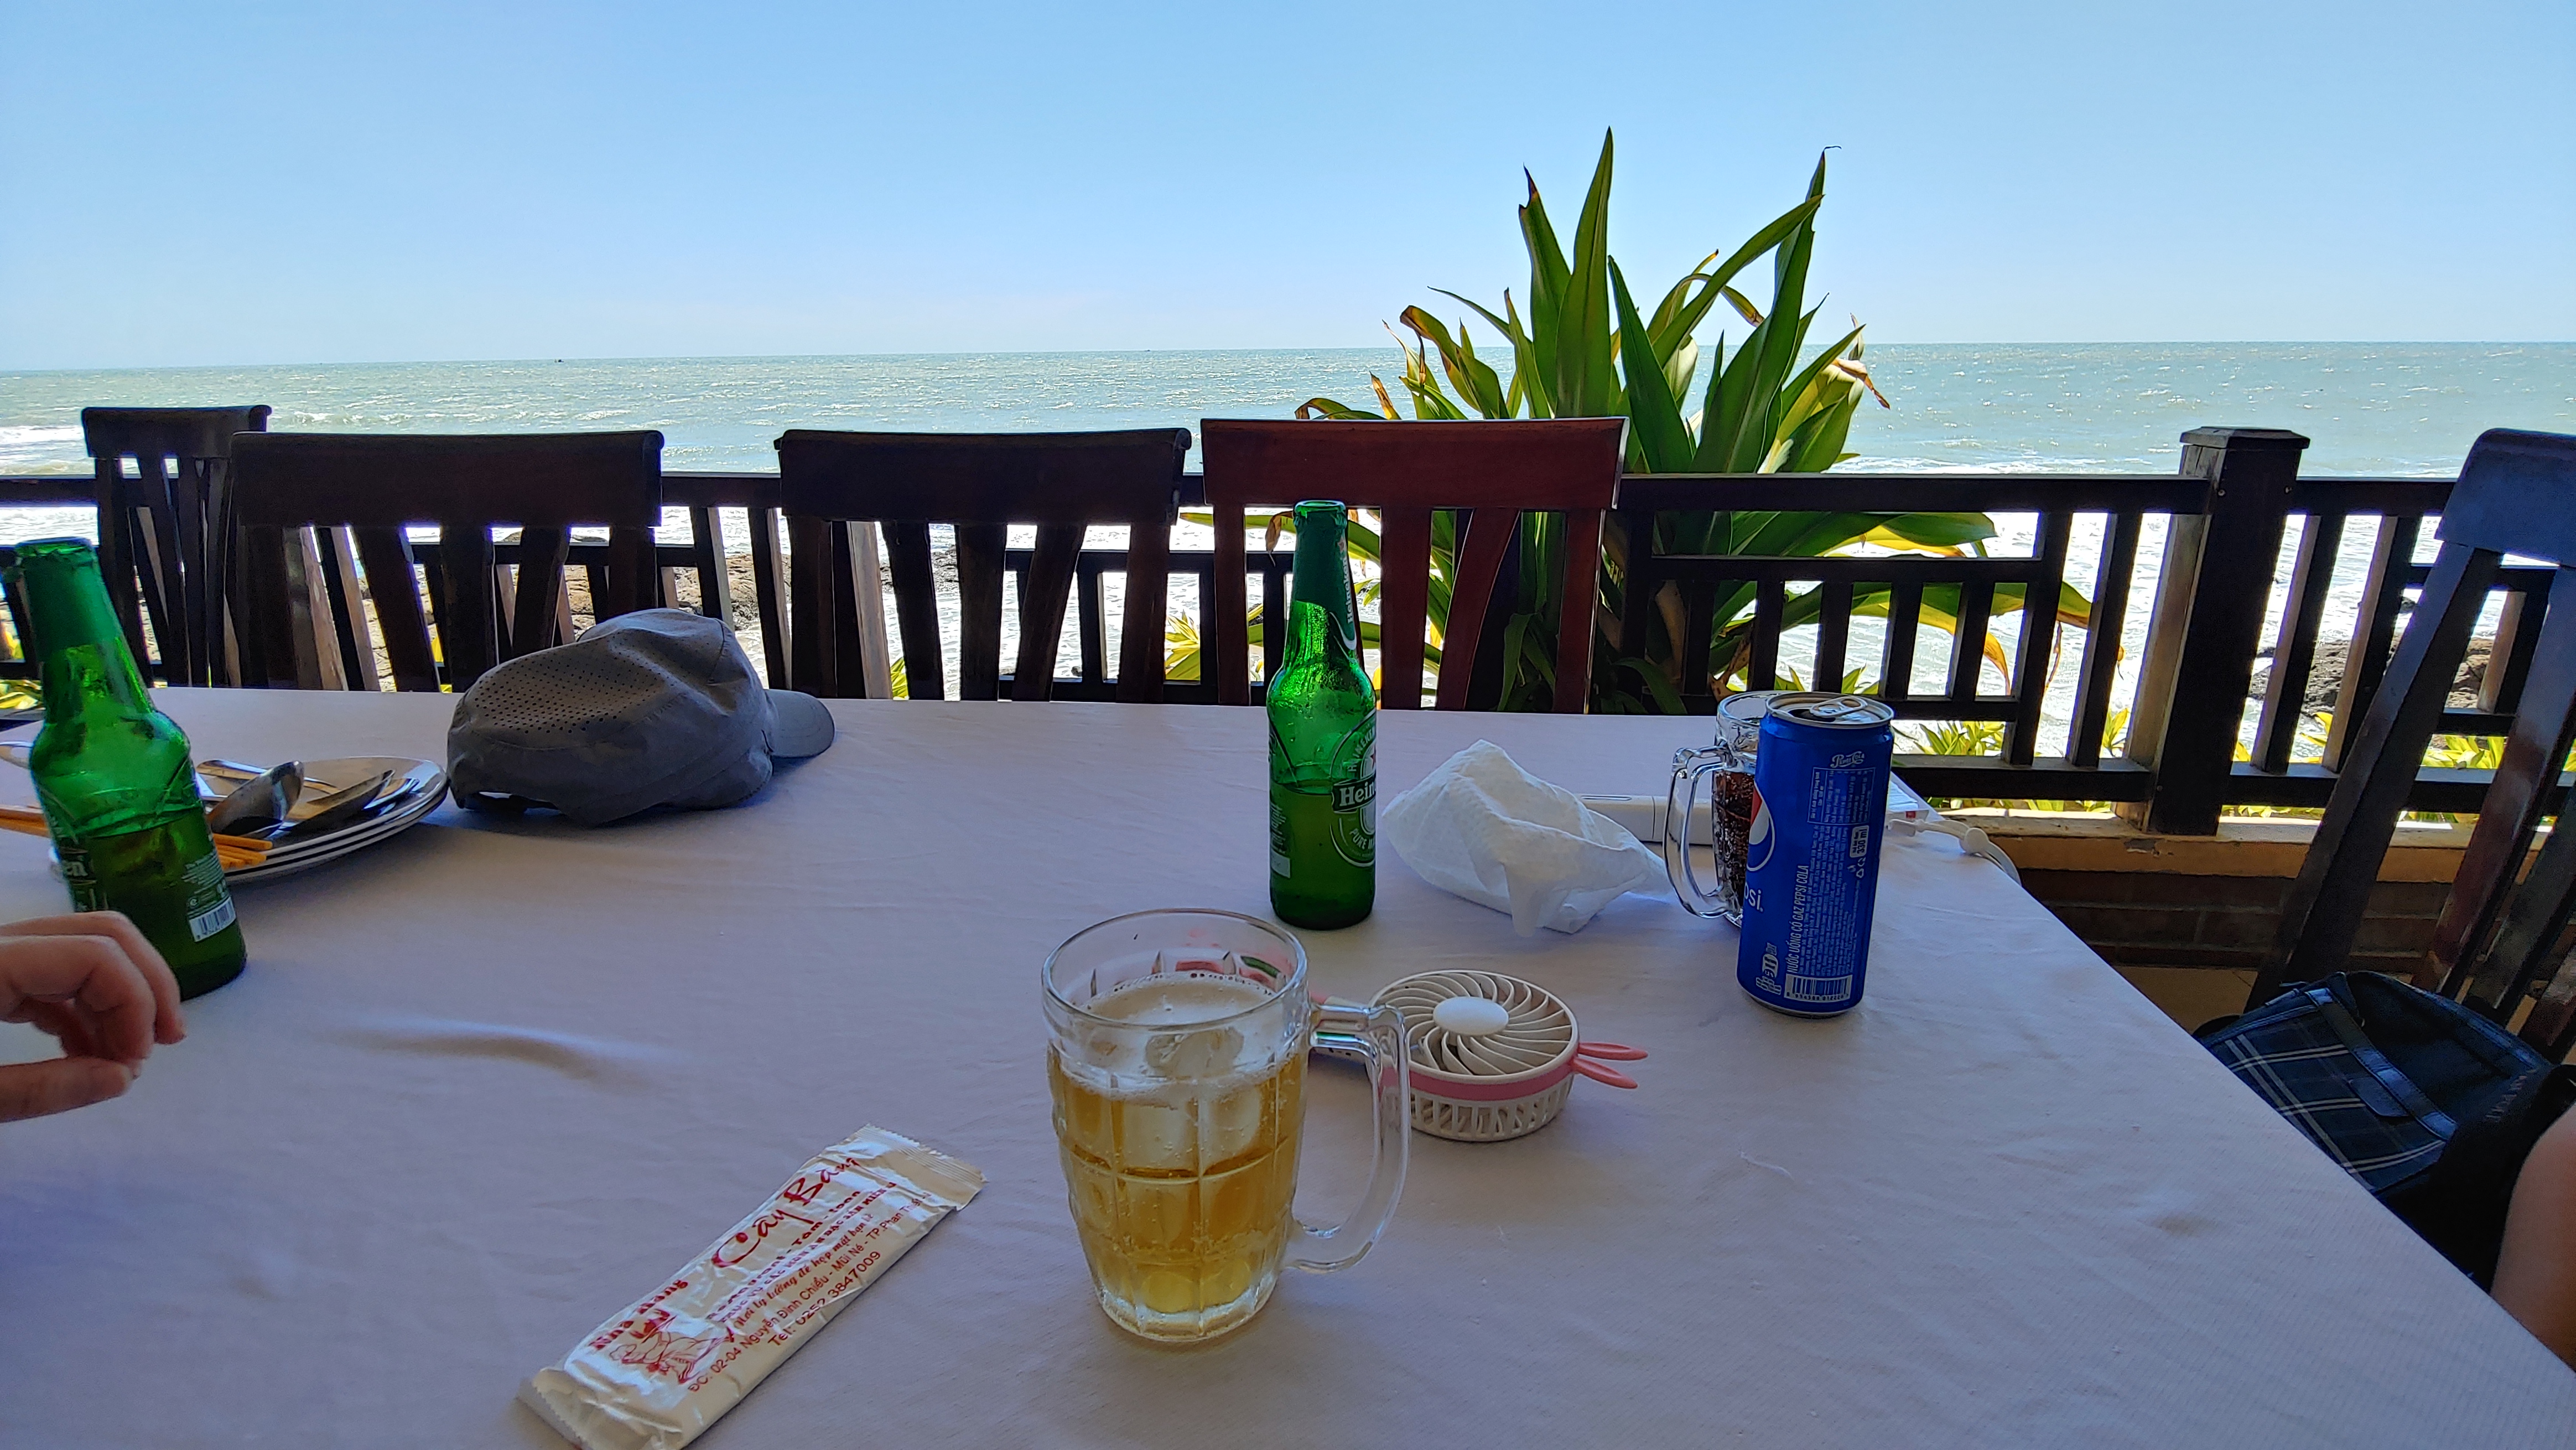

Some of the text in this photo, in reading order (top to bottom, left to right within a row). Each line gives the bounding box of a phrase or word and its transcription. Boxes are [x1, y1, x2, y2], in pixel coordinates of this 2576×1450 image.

[1339, 781, 1376, 806] Hein
[1349, 828, 1367, 850] PURE
[1857, 828, 1867, 854] 330 ml
[1796, 866, 1809, 884] COLA
[1794, 885, 1807, 906] PEPSI
[1793, 905, 1805, 920] GAZ
[1789, 921, 1803, 931] CÓ
[1786, 933, 1801, 952] UỐNG
[711, 1209, 814, 1268] Cây
[848, 1223, 866, 1236] bạn
[707, 1256, 786, 1319] Restaurant
[767, 1327, 796, 1345] Tel:
[827, 1251, 881, 1297] 3847009
[710, 1347, 742, 1375] 02-04
[740, 1317, 779, 1348] Nguyễn
[776, 1299, 802, 1318] Đình
[799, 1276, 829, 1299] Chiểu
[832, 1255, 851, 1271] Mũi
[848, 1244, 864, 1256] Né
